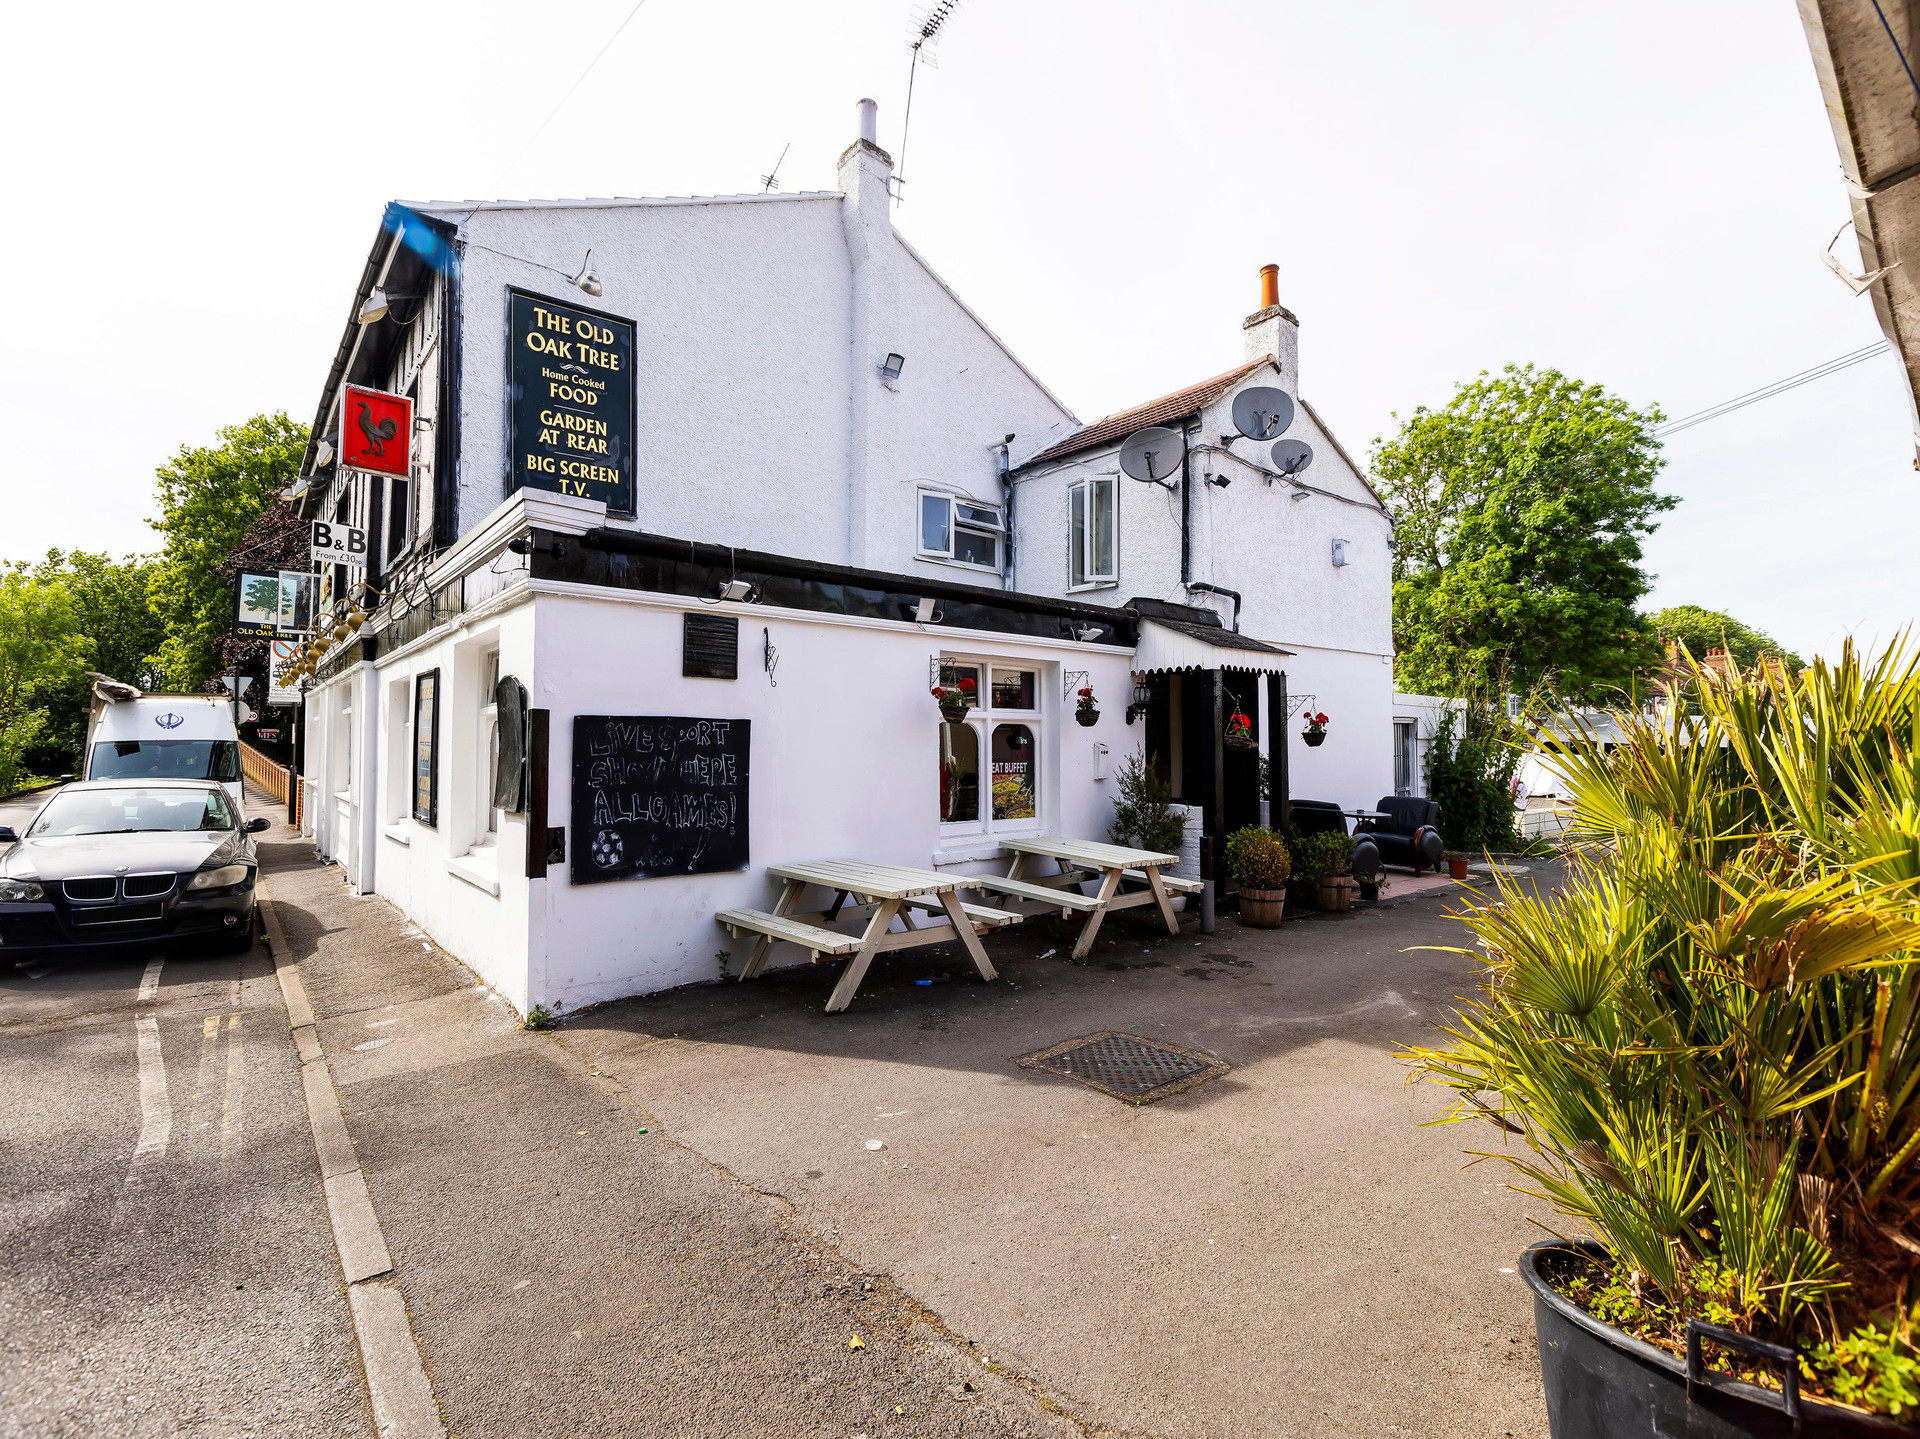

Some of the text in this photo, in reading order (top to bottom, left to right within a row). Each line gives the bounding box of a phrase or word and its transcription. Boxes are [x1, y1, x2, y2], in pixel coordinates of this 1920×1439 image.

[533, 307, 614, 345] THE OLD
[526, 331, 620, 371] OAK TREE
[542, 367, 605, 391] Home Cooked
[550, 382, 598, 406] FOOD
[540, 410, 608, 437] GARDEN
[539, 428, 608, 455] AT REAR
[527, 454, 620, 484] BIG SCREEN
[559, 478, 591, 498] T.V.
[316, 550, 337, 561] From
[237, 627, 254, 636] OLD
[255, 629, 274, 637] OAK
[1004, 762, 1027, 773] BUFFET
[593, 789, 650, 826] ALL
